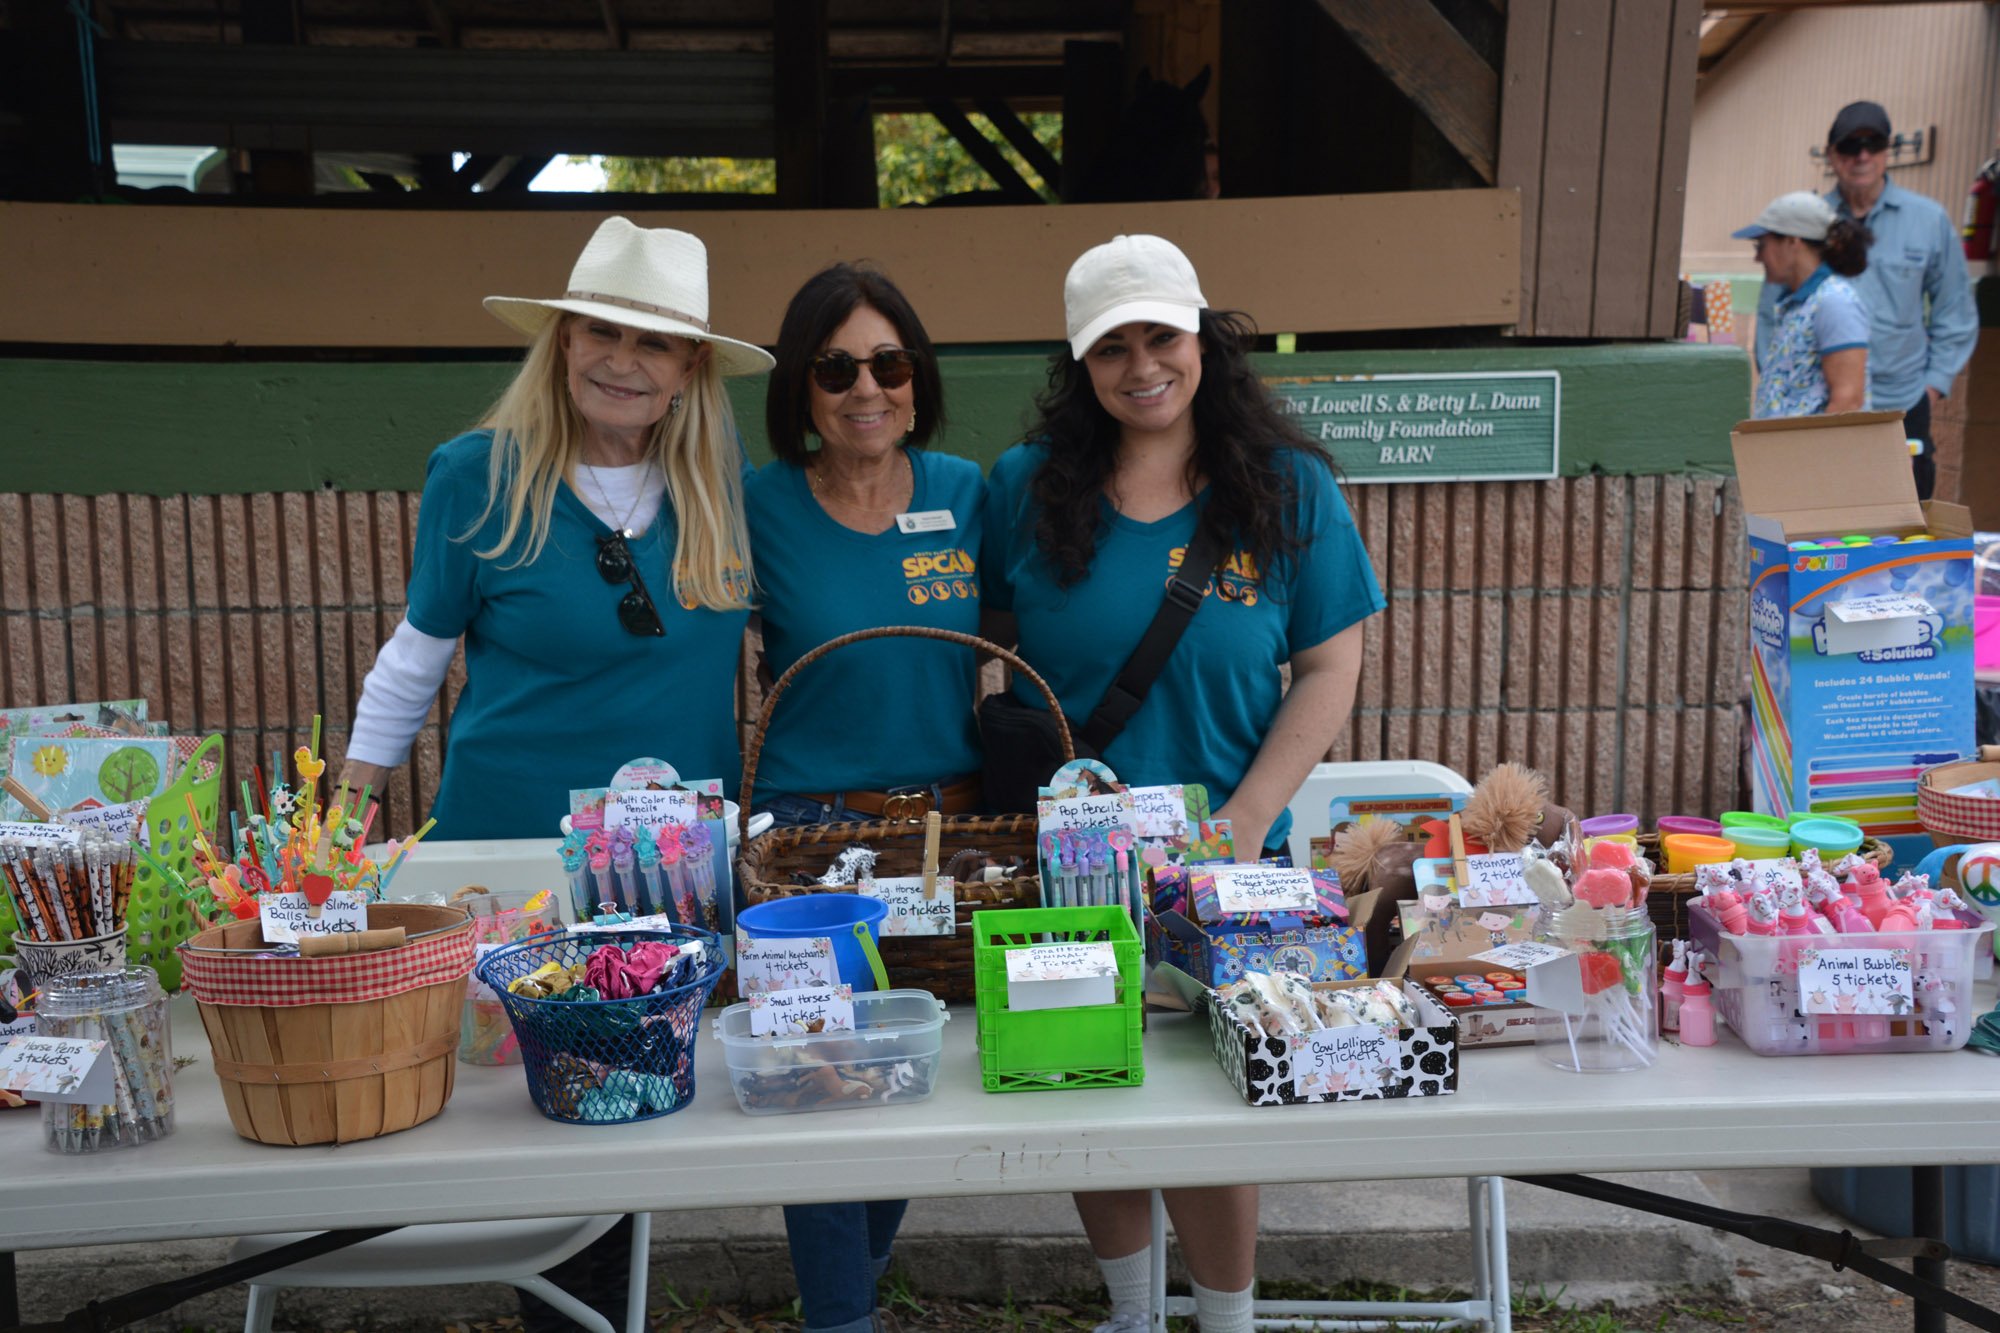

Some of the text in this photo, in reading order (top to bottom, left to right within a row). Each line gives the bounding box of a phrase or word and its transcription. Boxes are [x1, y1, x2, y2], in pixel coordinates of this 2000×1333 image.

[1311, 395, 1372, 415] Lowell
[1375, 395, 1393, 413] S.
[1397, 395, 1412, 412] &
[1415, 393, 1465, 416] Betty
[1469, 393, 1487, 411] L.
[1490, 391, 1541, 411] Dunn
[1320, 418, 1494, 443] Family Foundation
[1379, 445, 1436, 465] BARN
[1794, 553, 1849, 573] JOYIN
[1872, 646, 1933, 661] Solution
[1815, 671, 1951, 688] Includes 24 Bubble Wands!
[1822, 702, 1838, 710] with
[1840, 701, 1860, 709] these
[1890, 697, 1914, 706] bubble
[1917, 696, 1943, 704] wands!
[1837, 693, 1862, 702] Create
[1900, 690, 1928, 698] bubbles
[1892, 712, 1927, 721] designed
[1824, 731, 1848, 740] Wands
[1888, 728, 1915, 736] vibrant
[616, 794, 686, 807] Multi Color Pop
[1134, 792, 1165, 806] mpers
[625, 804, 658, 813] Pencils
[1059, 800, 1124, 819] Pop Pencils
[1136, 802, 1174, 814] Tickets
[103, 809, 134, 822] Books
[624, 813, 675, 826] 5 tickets
[33, 824, 73, 833] Pencils
[1063, 815, 1119, 831] 5 tickets
[1470, 857, 1522, 871] Stamper
[1480, 868, 1523, 883] 2 ticke
[895, 884, 924, 895] Horse
[1232, 876, 1309, 890] Fidget Spinners
[1234, 885, 1288, 898] 5 tickets
[280, 897, 359, 911] Gala Slime
[897, 900, 952, 917] 10 tickets
[268, 907, 303, 921] Balls
[742, 950, 760, 961] Farm
[761, 949, 787, 960] Animal
[1031, 945, 1097, 956] Small Farm
[765, 959, 809, 972] 4 tickets
[1817, 956, 1910, 972] Animal Bubbles
[1832, 972, 1898, 987] 5 tickets
[769, 994, 831, 1007] Small Horses
[780, 1005, 827, 1025] ticket
[24, 1041, 84, 1055] Horse Pens
[1312, 1036, 1386, 1054] Cow Lollipops
[13, 1052, 71, 1066] 3 tickets
[1315, 1054, 1324, 1068] 5
